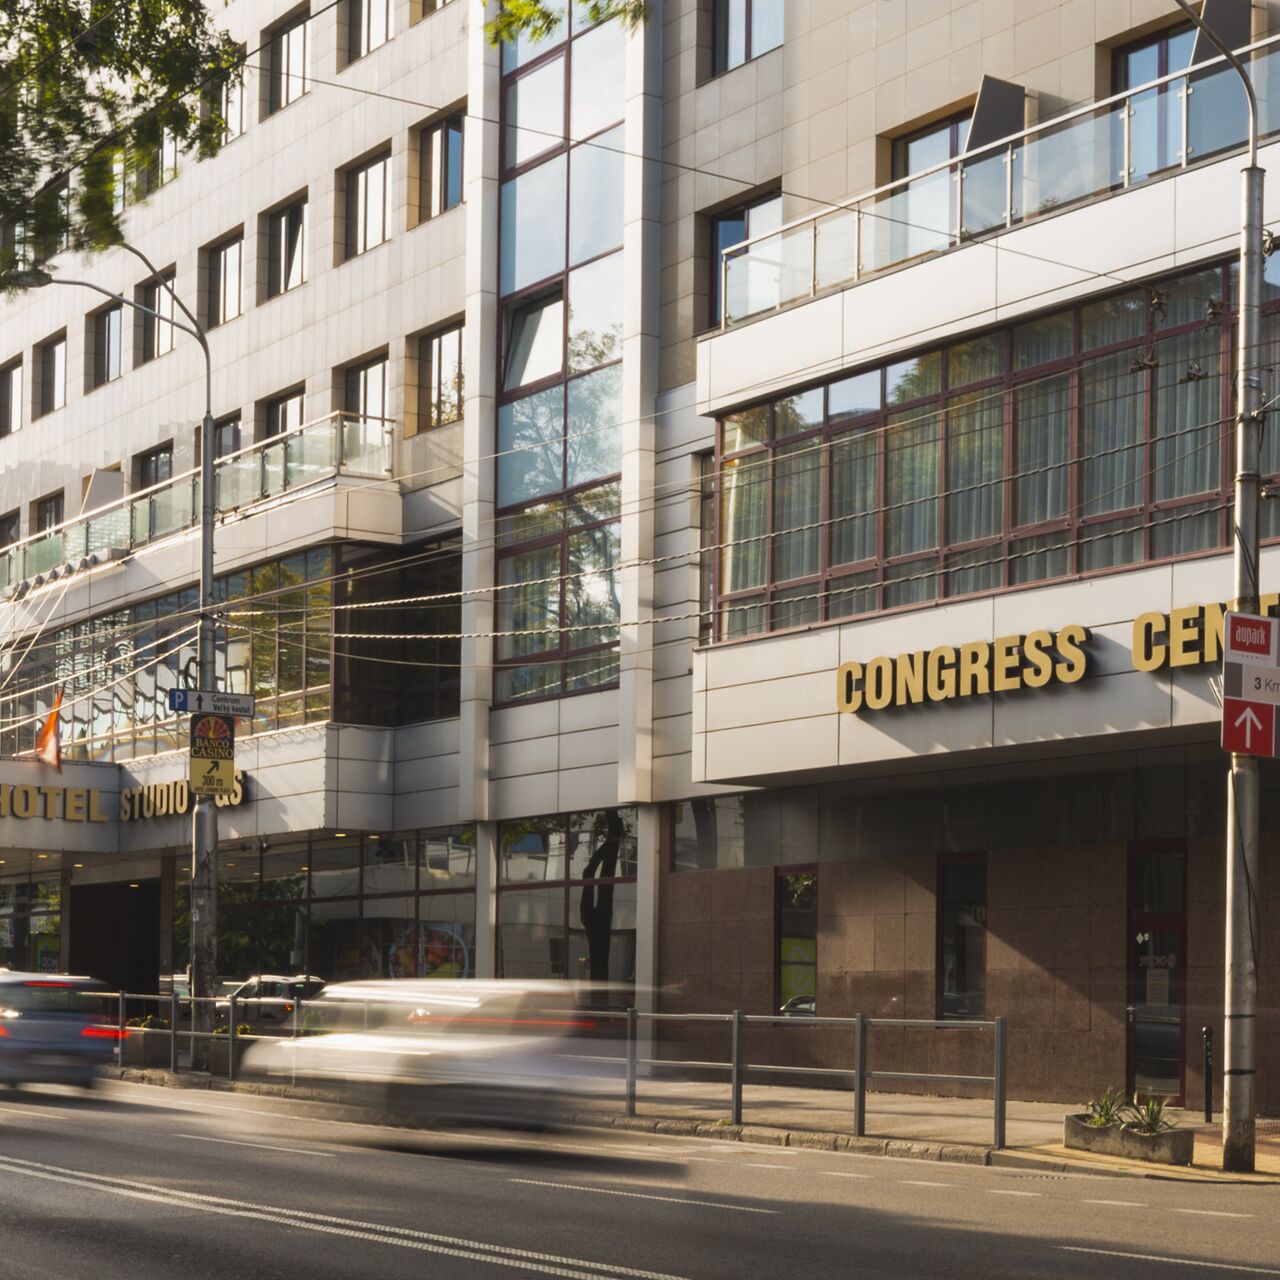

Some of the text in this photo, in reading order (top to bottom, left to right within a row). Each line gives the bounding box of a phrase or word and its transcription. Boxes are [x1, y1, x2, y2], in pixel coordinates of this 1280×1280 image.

[1235, 625, 1266, 646] aupark
[837, 624, 1087, 713] CONGRESS
[1254, 676, 1262, 690] 3
[211, 694, 241, 705] Centrum
[195, 739, 230, 749] BANCO
[191, 747, 234, 759] CASINO
[202, 775, 224, 787] 300 m
[121, 778, 189, 822] STUDIO
